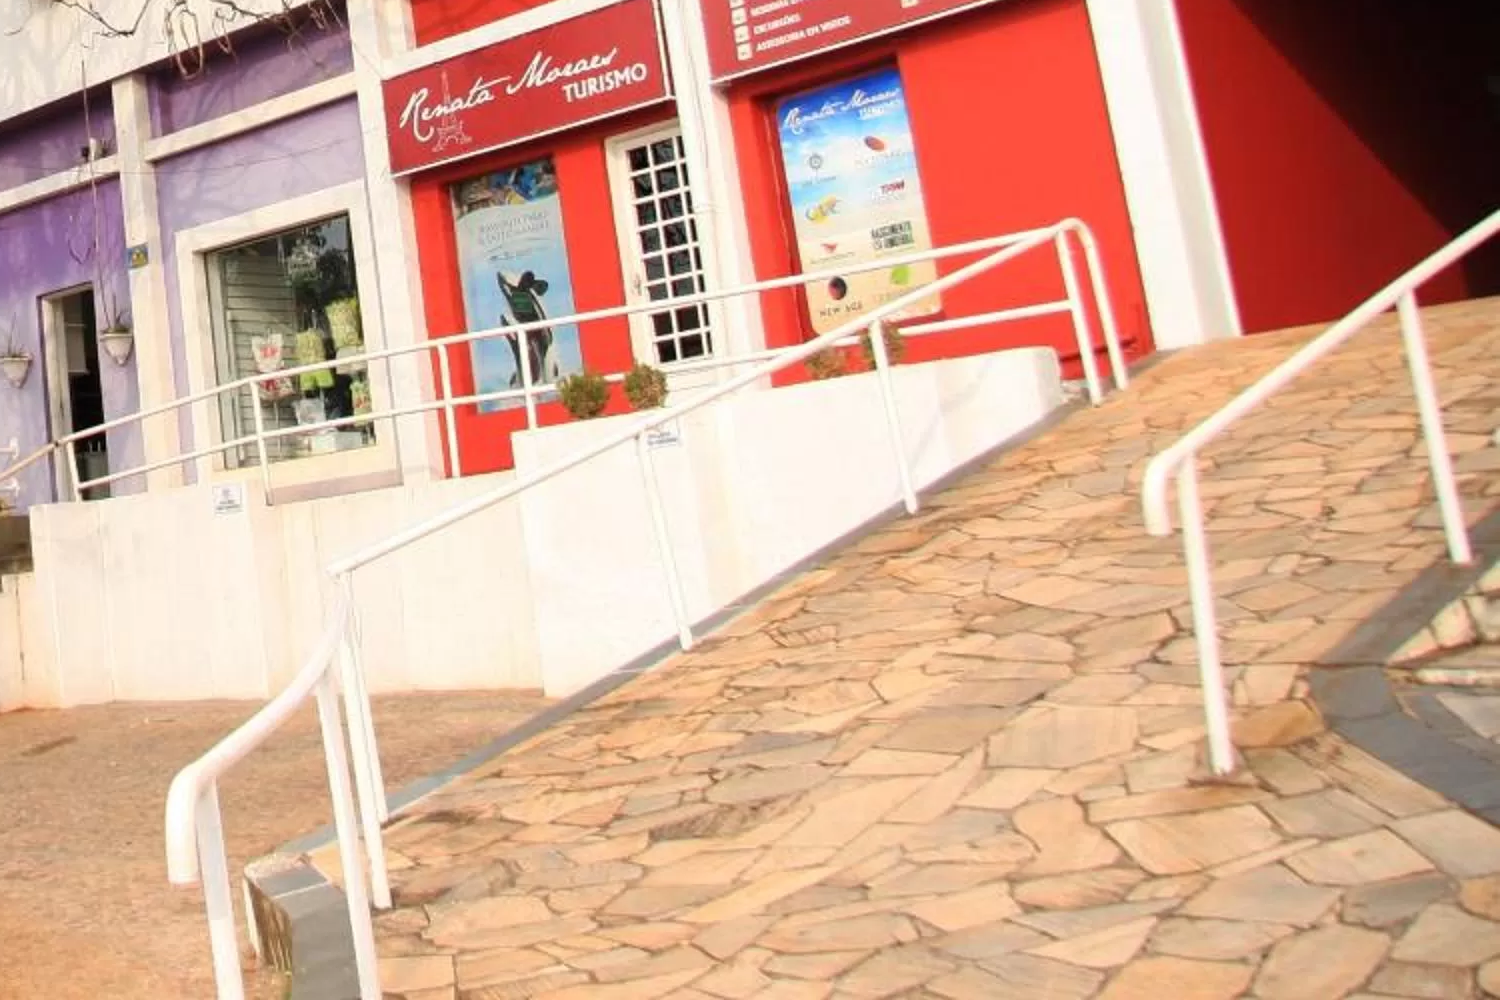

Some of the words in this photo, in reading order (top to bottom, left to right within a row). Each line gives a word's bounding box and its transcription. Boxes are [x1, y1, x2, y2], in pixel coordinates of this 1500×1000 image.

[400, 76, 512, 142] Renata
[506, 48, 618, 96] Moraes
[562, 62, 648, 103] TURISMO
